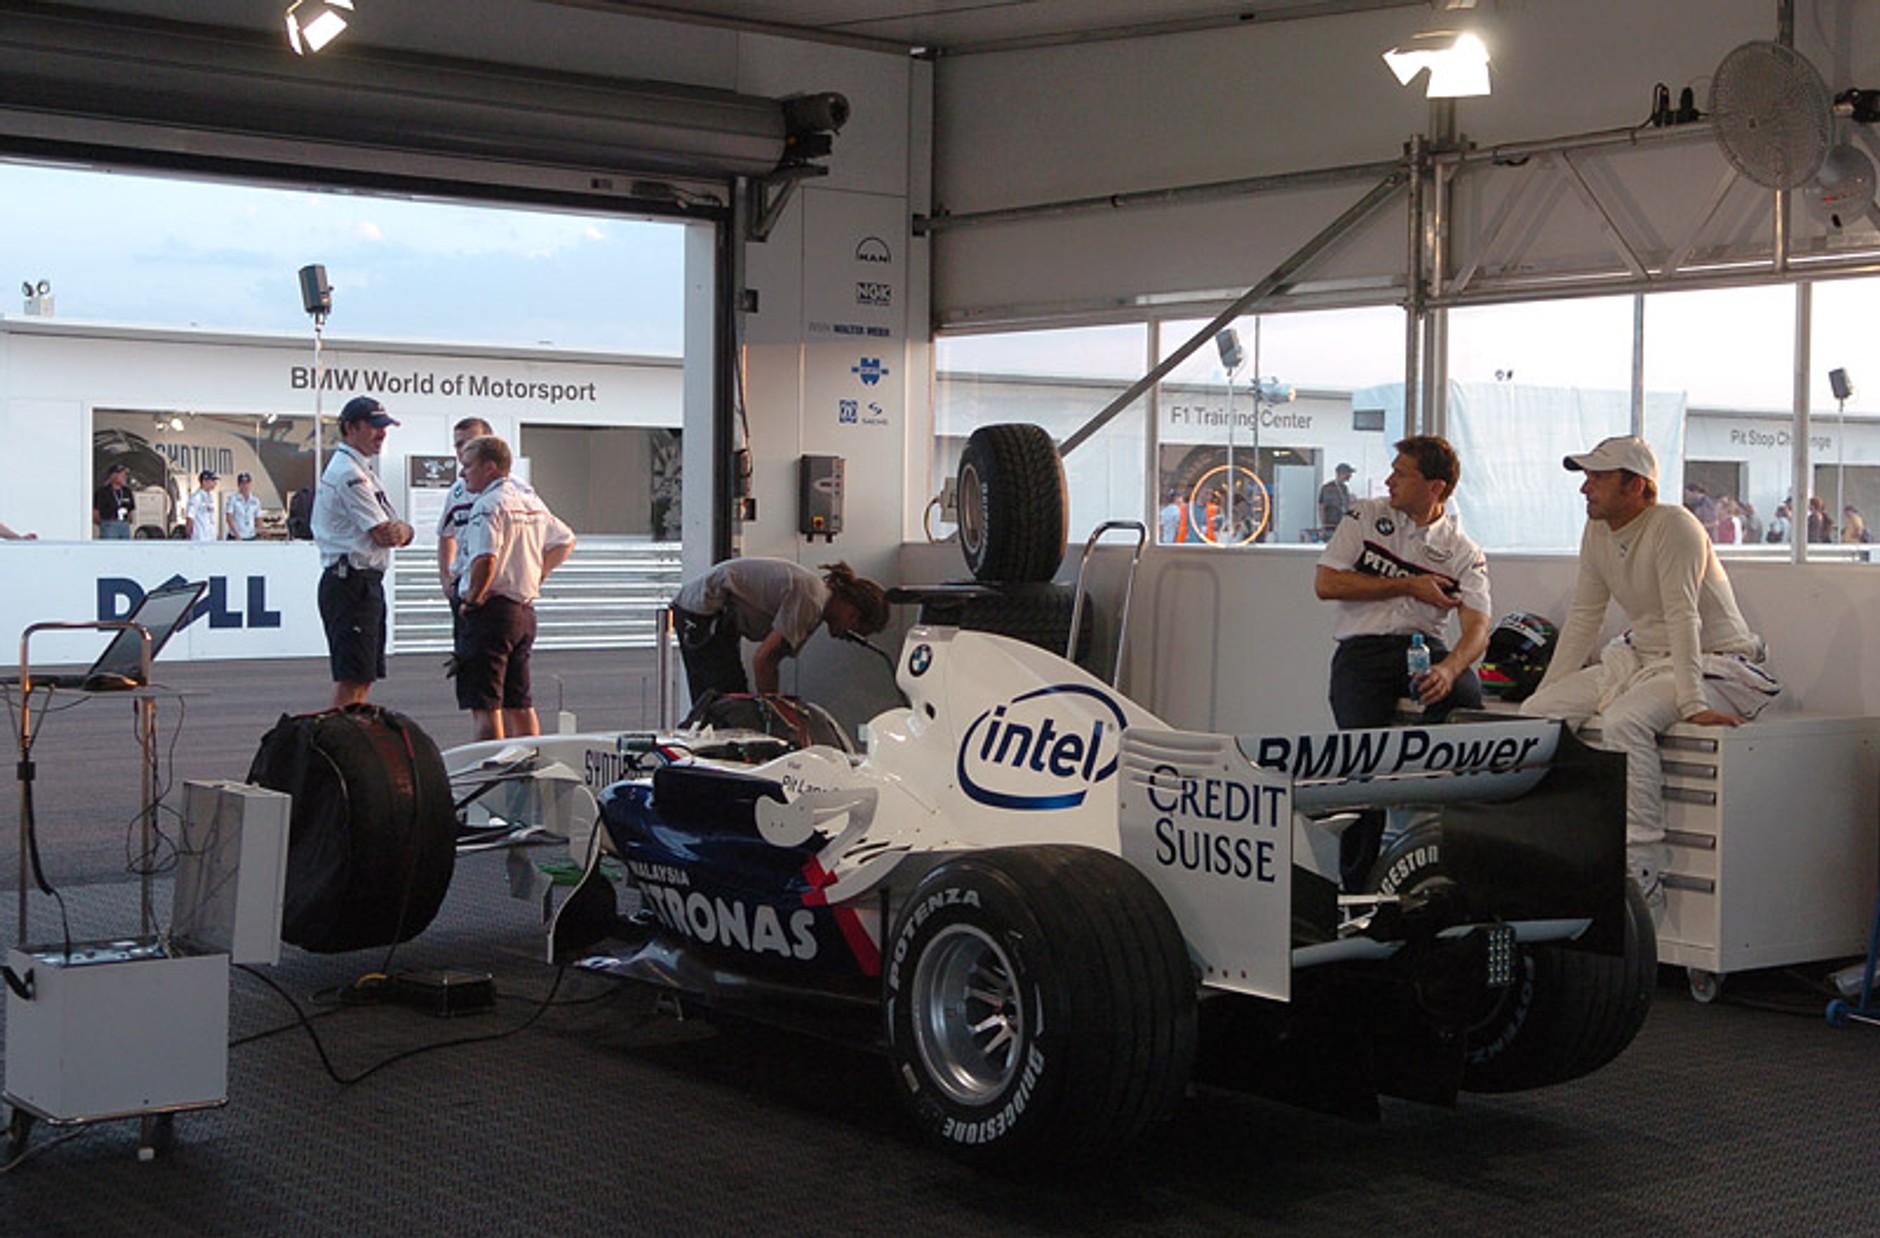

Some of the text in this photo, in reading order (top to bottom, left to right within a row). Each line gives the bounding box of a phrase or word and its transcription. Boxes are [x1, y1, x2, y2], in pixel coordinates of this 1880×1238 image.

[859, 253, 888, 263] MAN
[291, 367, 597, 403] BMW World of Motorsport
[1171, 405, 1313, 431] F1 Training Center
[1730, 429, 1832, 451] Pit Stop Chnge
[980, 705, 1104, 783] intel
[1257, 730, 1539, 787] BMW Power
[1147, 764, 1287, 828] CREDIT
[1155, 817, 1276, 884] SUISSE
[888, 887, 982, 991] POTENZA
[942, 1041, 1045, 1145] BRIDGESTONE
